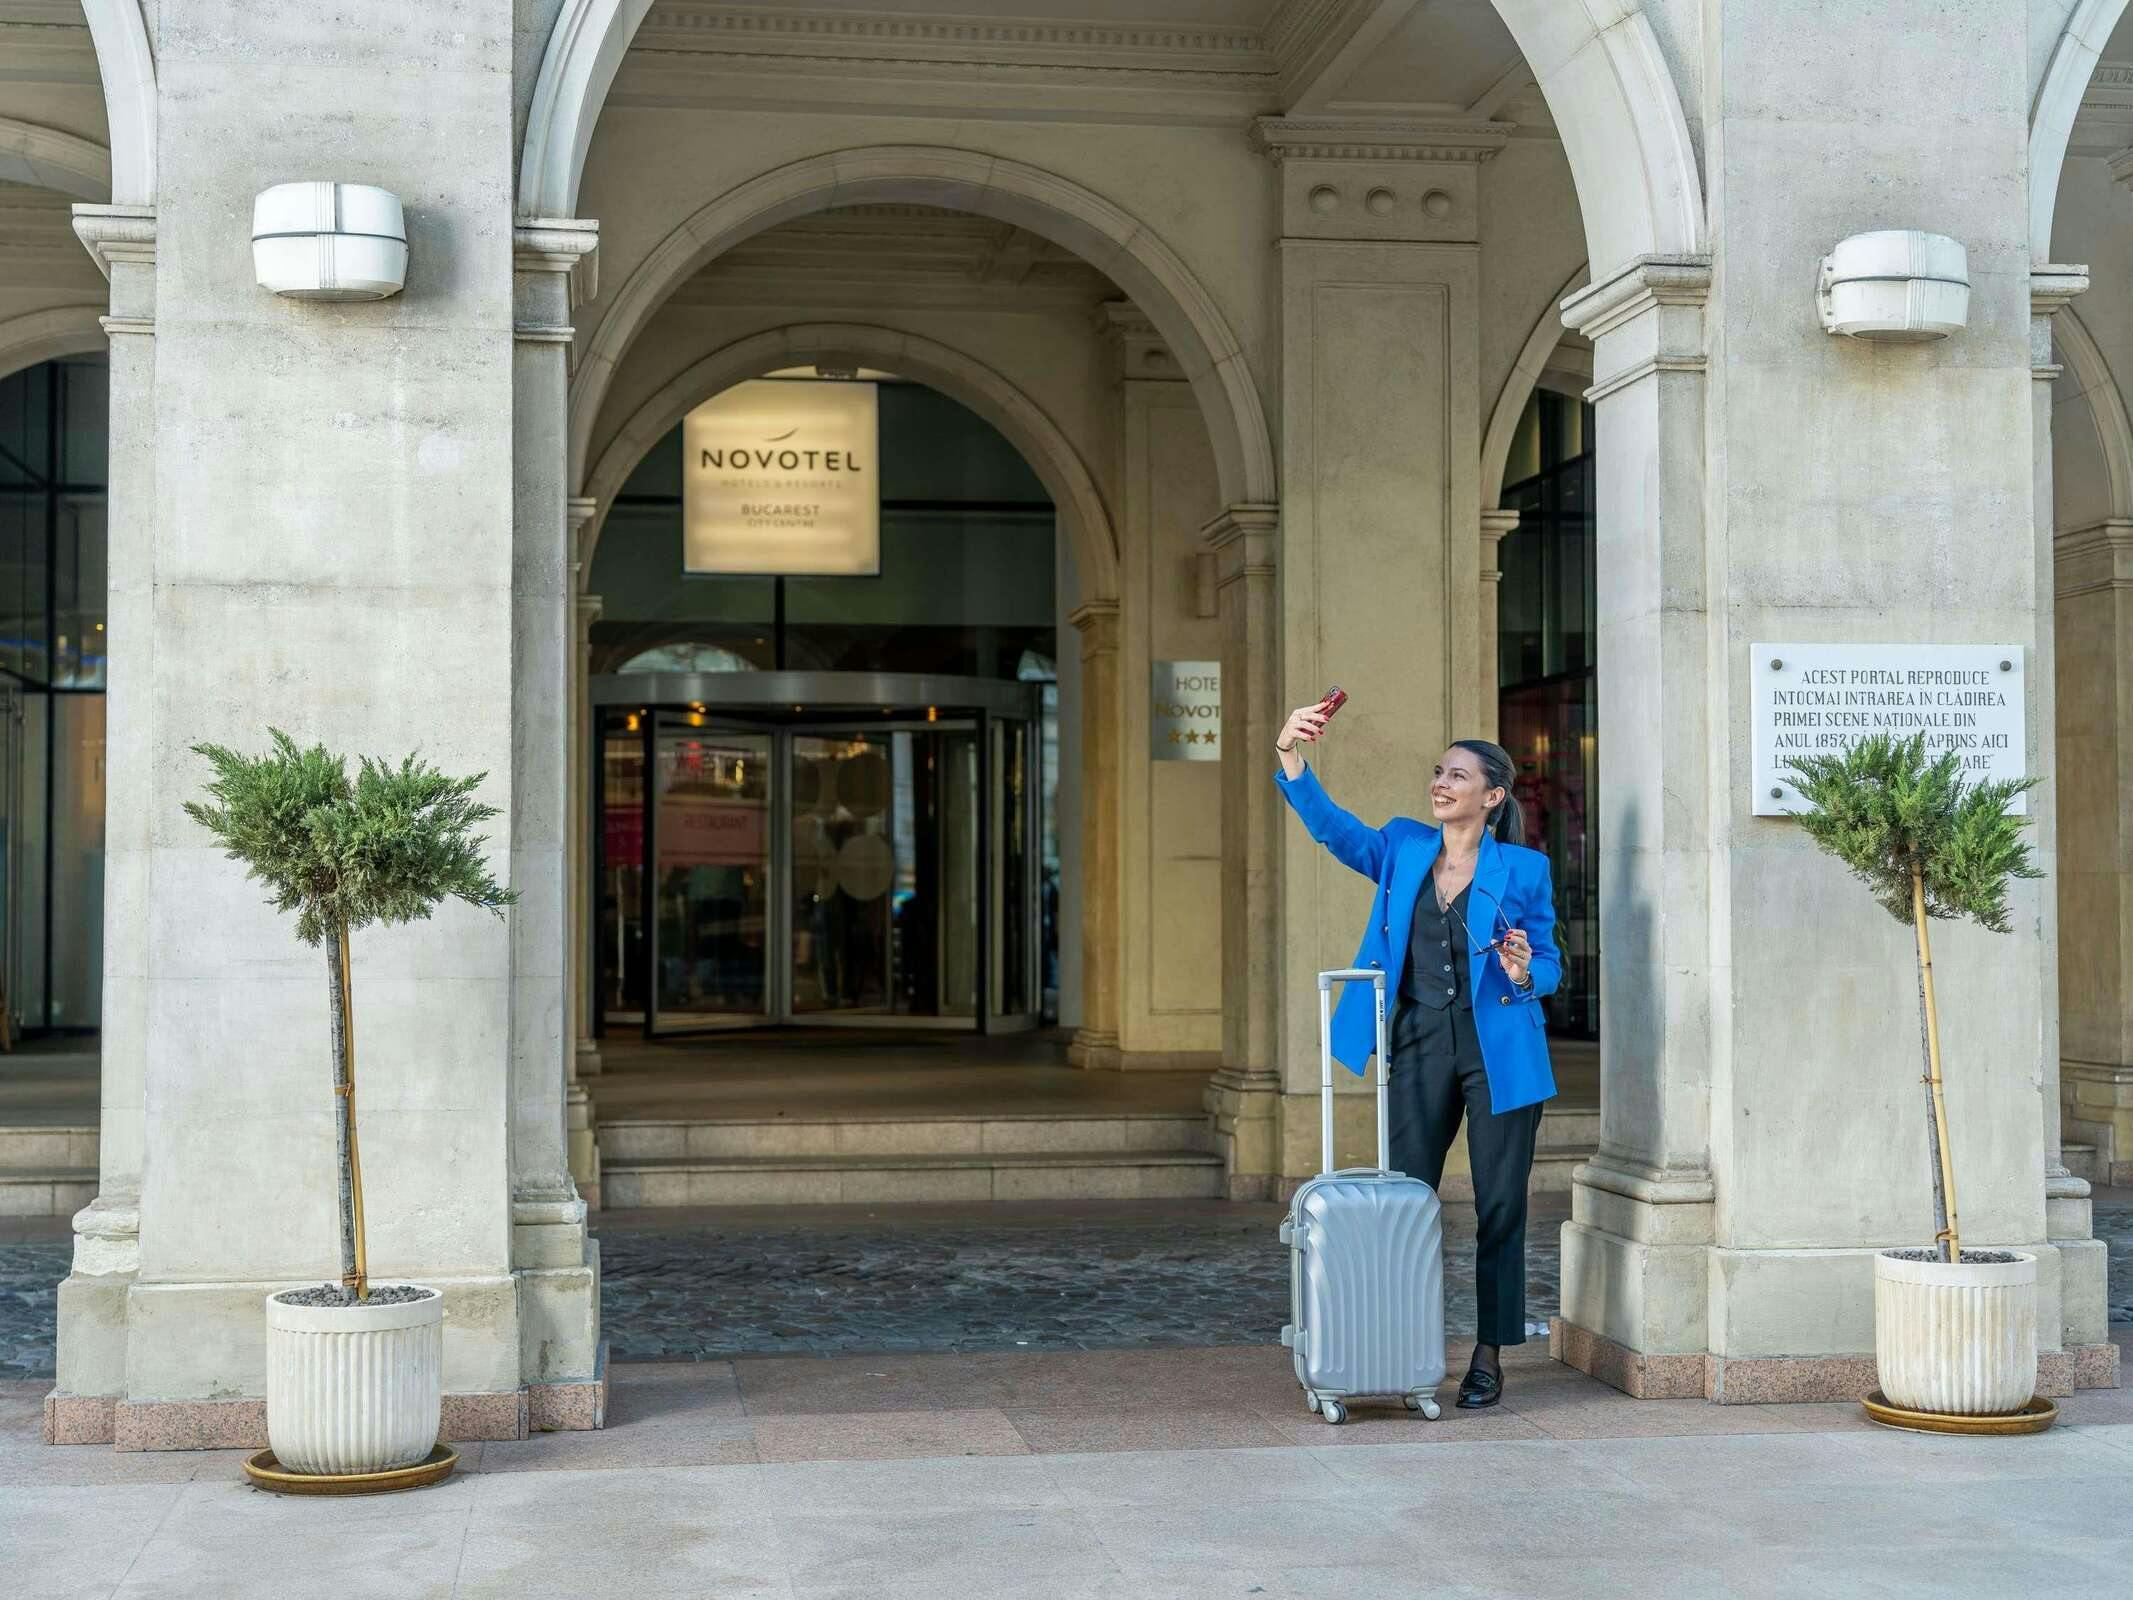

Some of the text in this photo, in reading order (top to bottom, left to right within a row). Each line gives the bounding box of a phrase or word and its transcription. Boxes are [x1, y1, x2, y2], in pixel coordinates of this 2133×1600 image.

[702, 449, 861, 472] NOVOTEL
[741, 503, 820, 516] BUCAREST
[1802, 670, 1990, 686] ACEST PORTAL REPRODUCE
[1845, 691, 1915, 706] INTRAREA
[1774, 712, 1821, 727] PRIMEI
[1825, 712, 1869, 727] SCENE
[1954, 712, 1976, 727] DIN
[1775, 733, 1812, 748] ANUL
[1816, 733, 1847, 748] 1852
[1927, 734, 1977, 748] APRINS
[1981, 734, 2008, 748] AICI
